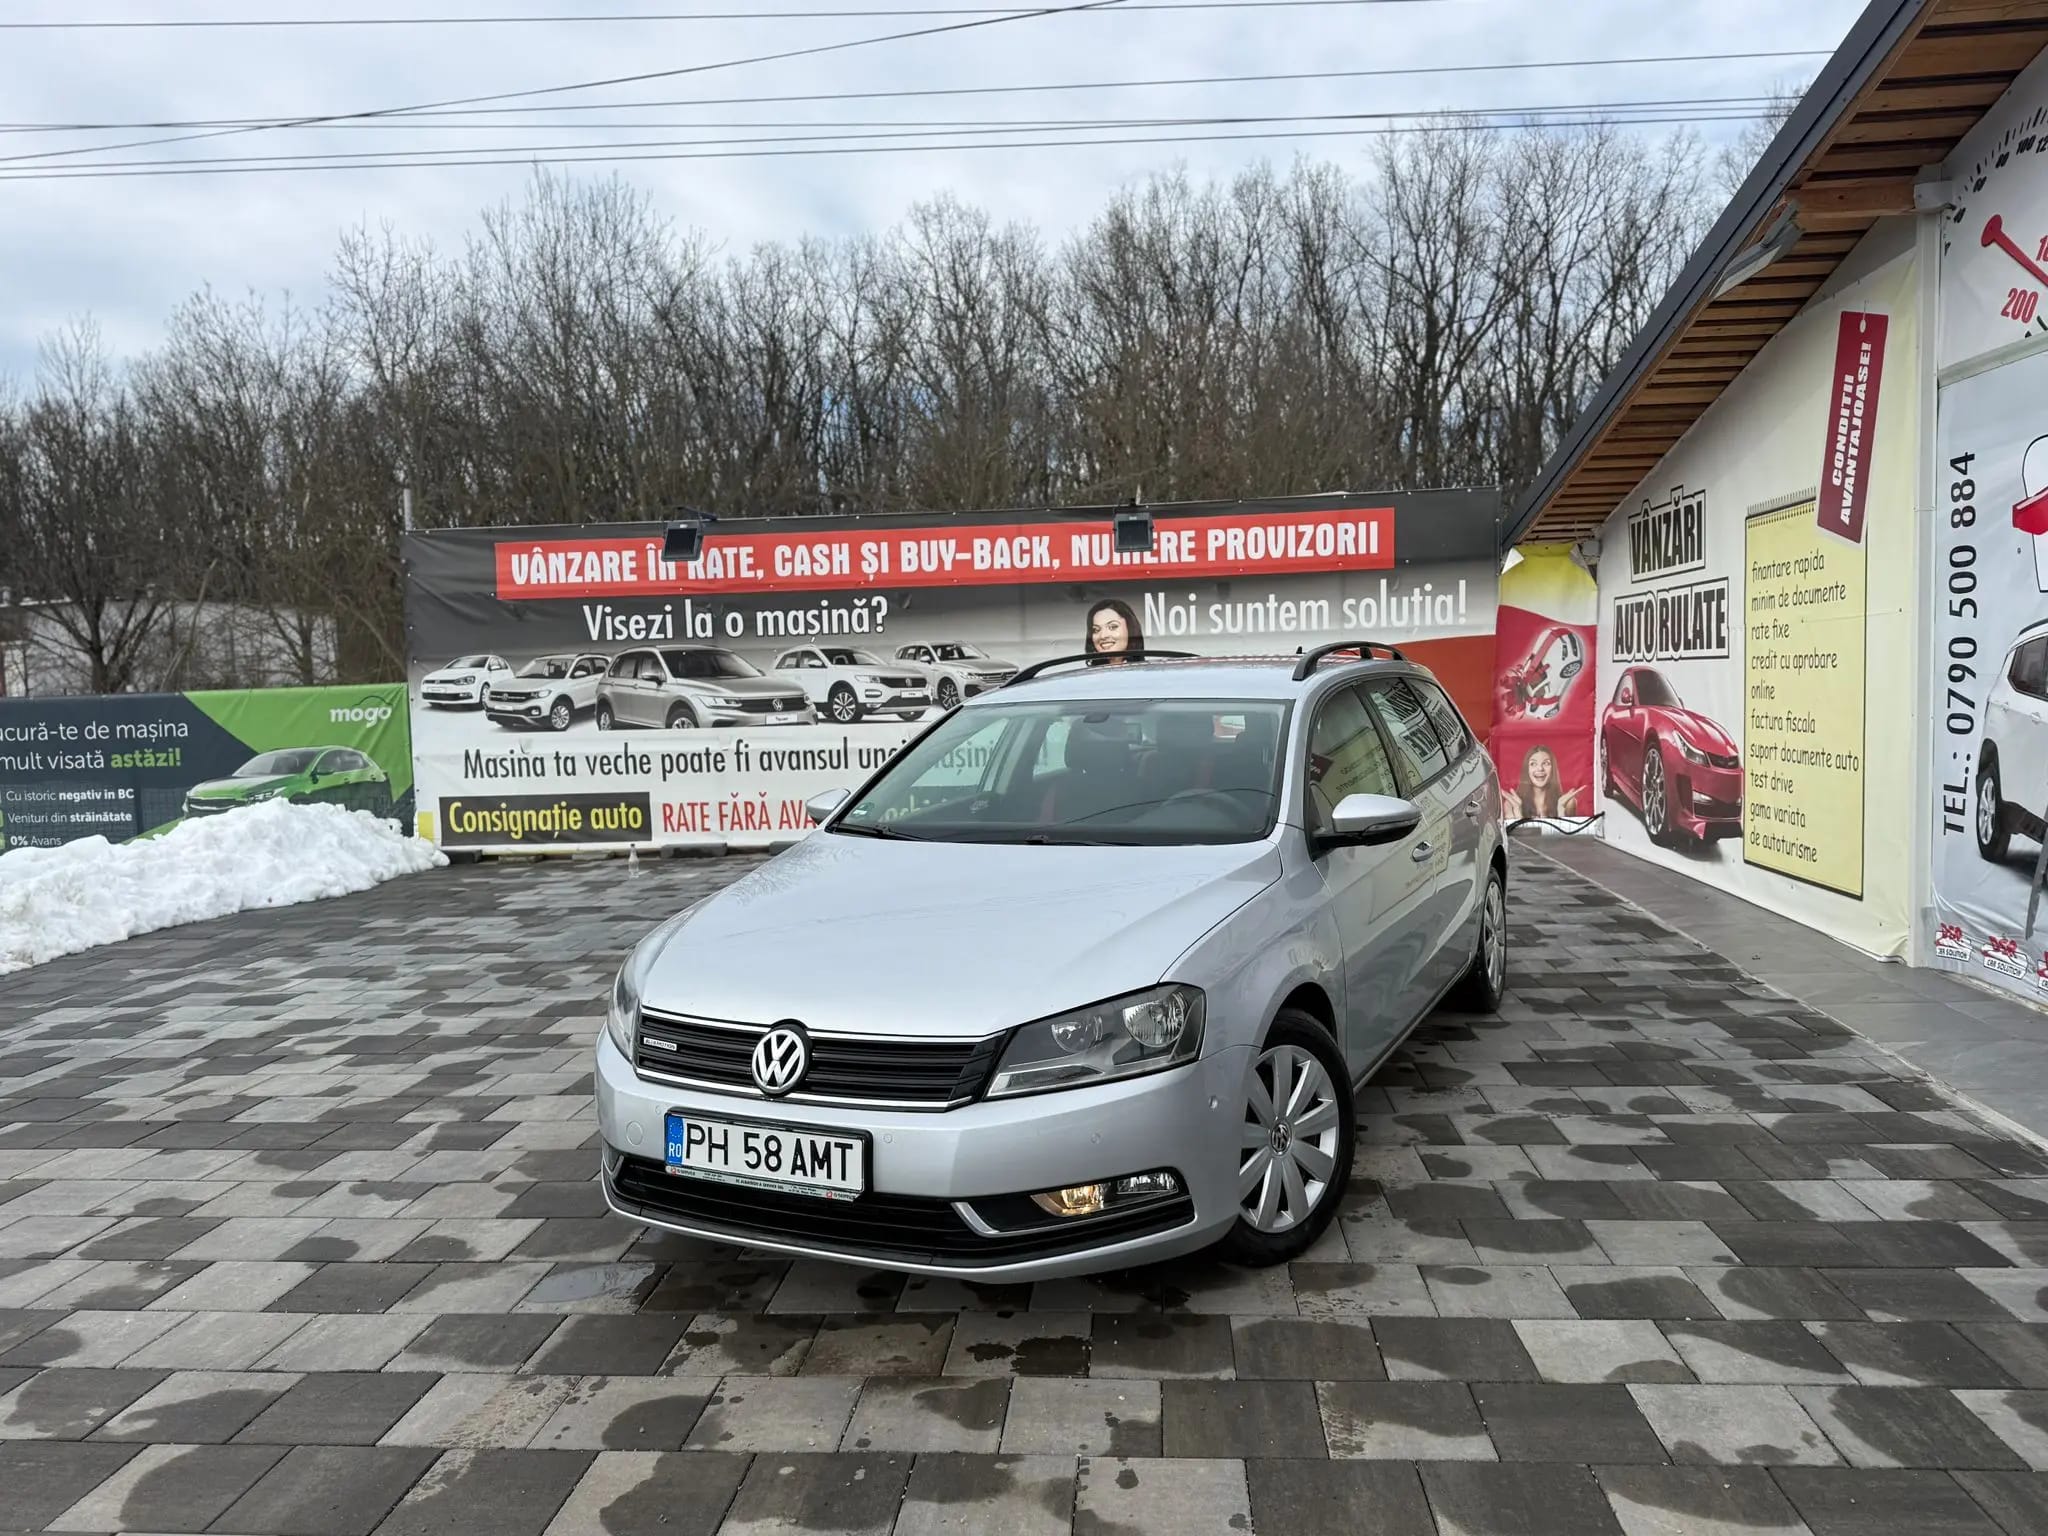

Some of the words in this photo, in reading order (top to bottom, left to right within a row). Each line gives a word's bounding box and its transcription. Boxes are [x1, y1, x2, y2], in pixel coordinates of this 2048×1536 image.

[2001, 288, 2038, 323] 200
[1840, 342, 1872, 526] AVANTAJOASE!
[1950, 451, 1975, 529] 884
[511, 546, 638, 585] VÂNZARE
[687, 546, 764, 580] RATE,
[774, 543, 850, 577] CASH
[861, 541, 889, 582] ȘI
[900, 535, 1060, 574] BUY-BACK,
[1207, 520, 1379, 562] PROVIZORII
[1631, 496, 1702, 575] VÂNZĂRI
[1752, 560, 1791, 583] finantare
[1793, 548, 1824, 580] rapida
[1949, 545, 1977, 619] 500
[1144, 592, 1197, 637] Noi
[1208, 593, 1329, 634] suntem
[1342, 578, 1467, 636] soluția!
[1752, 590, 1775, 611] minim
[1778, 586, 1790, 608] de
[1792, 581, 1846, 606] documente
[582, 604, 673, 641] Visezi
[685, 599, 713, 639] la
[725, 611, 743, 638] o
[756, 595, 888, 645] mașină?
[1615, 601, 1655, 654] AUTO
[1658, 588, 1725, 652] RULATE
[1752, 622, 1770, 640] rate
[1772, 618, 1790, 640] fixe
[1752, 648, 1777, 670] credit
[1780, 654, 1791, 669] cu
[1793, 647, 1838, 676] aprobare
[1751, 678, 1775, 700] online
[1946, 636, 1977, 735] 0790
[0, 722, 78, 742] cură-te
[84, 721, 110, 740] de
[116, 719, 188, 743] mașina
[330, 703, 392, 728] mogo
[1751, 708, 1783, 731] factura
[1785, 710, 1816, 734] fiscala
[47, 750, 104, 769] visată
[110, 747, 181, 768] astăzi!
[554, 751, 576, 777] ta
[585, 742, 651, 775] veche
[660, 747, 726, 782] poate
[734, 738, 750, 772] fi
[759, 736, 849, 771] avansul
[1750, 742, 1778, 765] suport
[1781, 742, 1832, 769] documente
[1835, 751, 1860, 772] auto
[6, 790, 22, 801] Cu
[24, 788, 57, 801] istoric
[58, 788, 101, 802] negativ
[118, 788, 135, 799] BC
[1750, 769, 1769, 789] test
[1771, 771, 1794, 794] drive
[1944, 751, 1971, 835] TEL.:
[8, 812, 48, 824] Venituri
[50, 811, 68, 823] din
[69, 811, 133, 822] străinătate
[449, 801, 582, 840] Consignație
[590, 802, 643, 829] auto
[662, 801, 711, 833] RATE
[718, 791, 772, 831] FĂRĂ
[1750, 802, 1771, 822] gama
[1774, 805, 1806, 828] variata
[10, 836, 29, 846] 0%
[31, 835, 62, 846] Avans
[1750, 826, 1761, 846] de
[1762, 834, 1818, 863] autoturisme
[669, 1142, 682, 1158] RO
[685, 1123, 729, 1165] PH
[743, 1131, 782, 1172] 58
[790, 1138, 853, 1181] AMT
